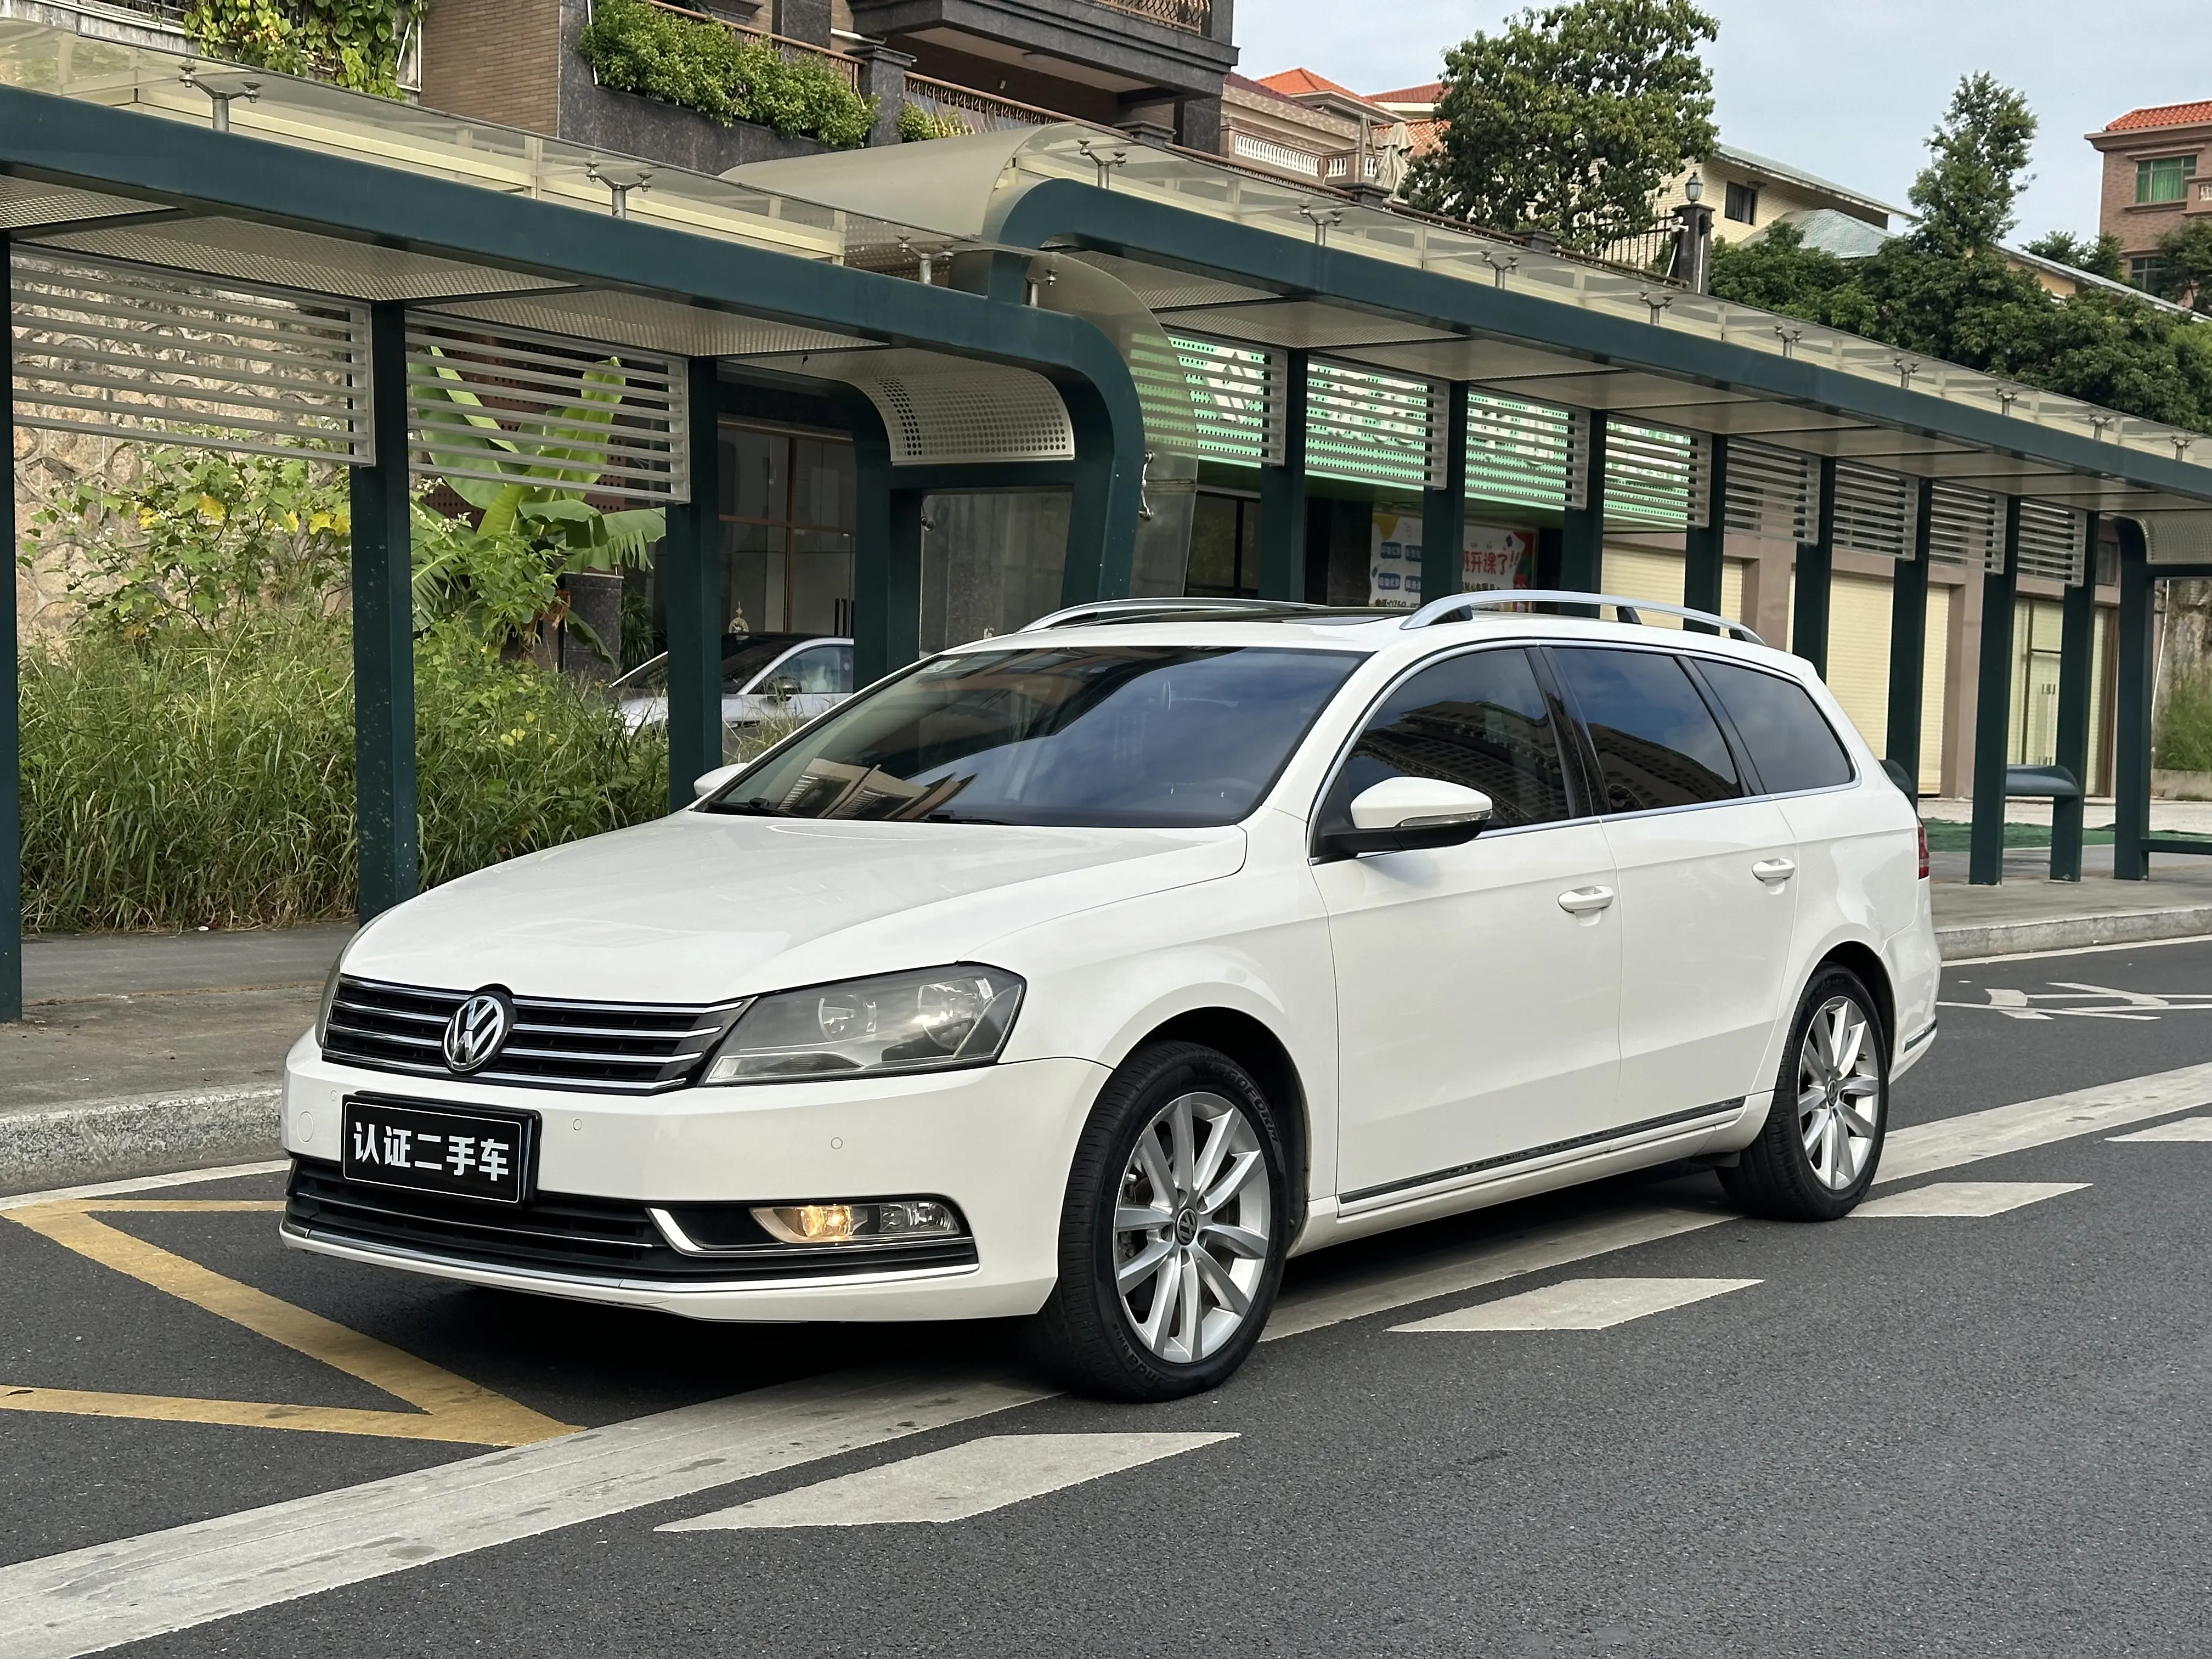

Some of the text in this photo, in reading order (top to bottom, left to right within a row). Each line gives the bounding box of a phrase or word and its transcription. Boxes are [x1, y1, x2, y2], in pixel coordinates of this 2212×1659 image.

[353, 1121, 509, 1181] 认证二手车
